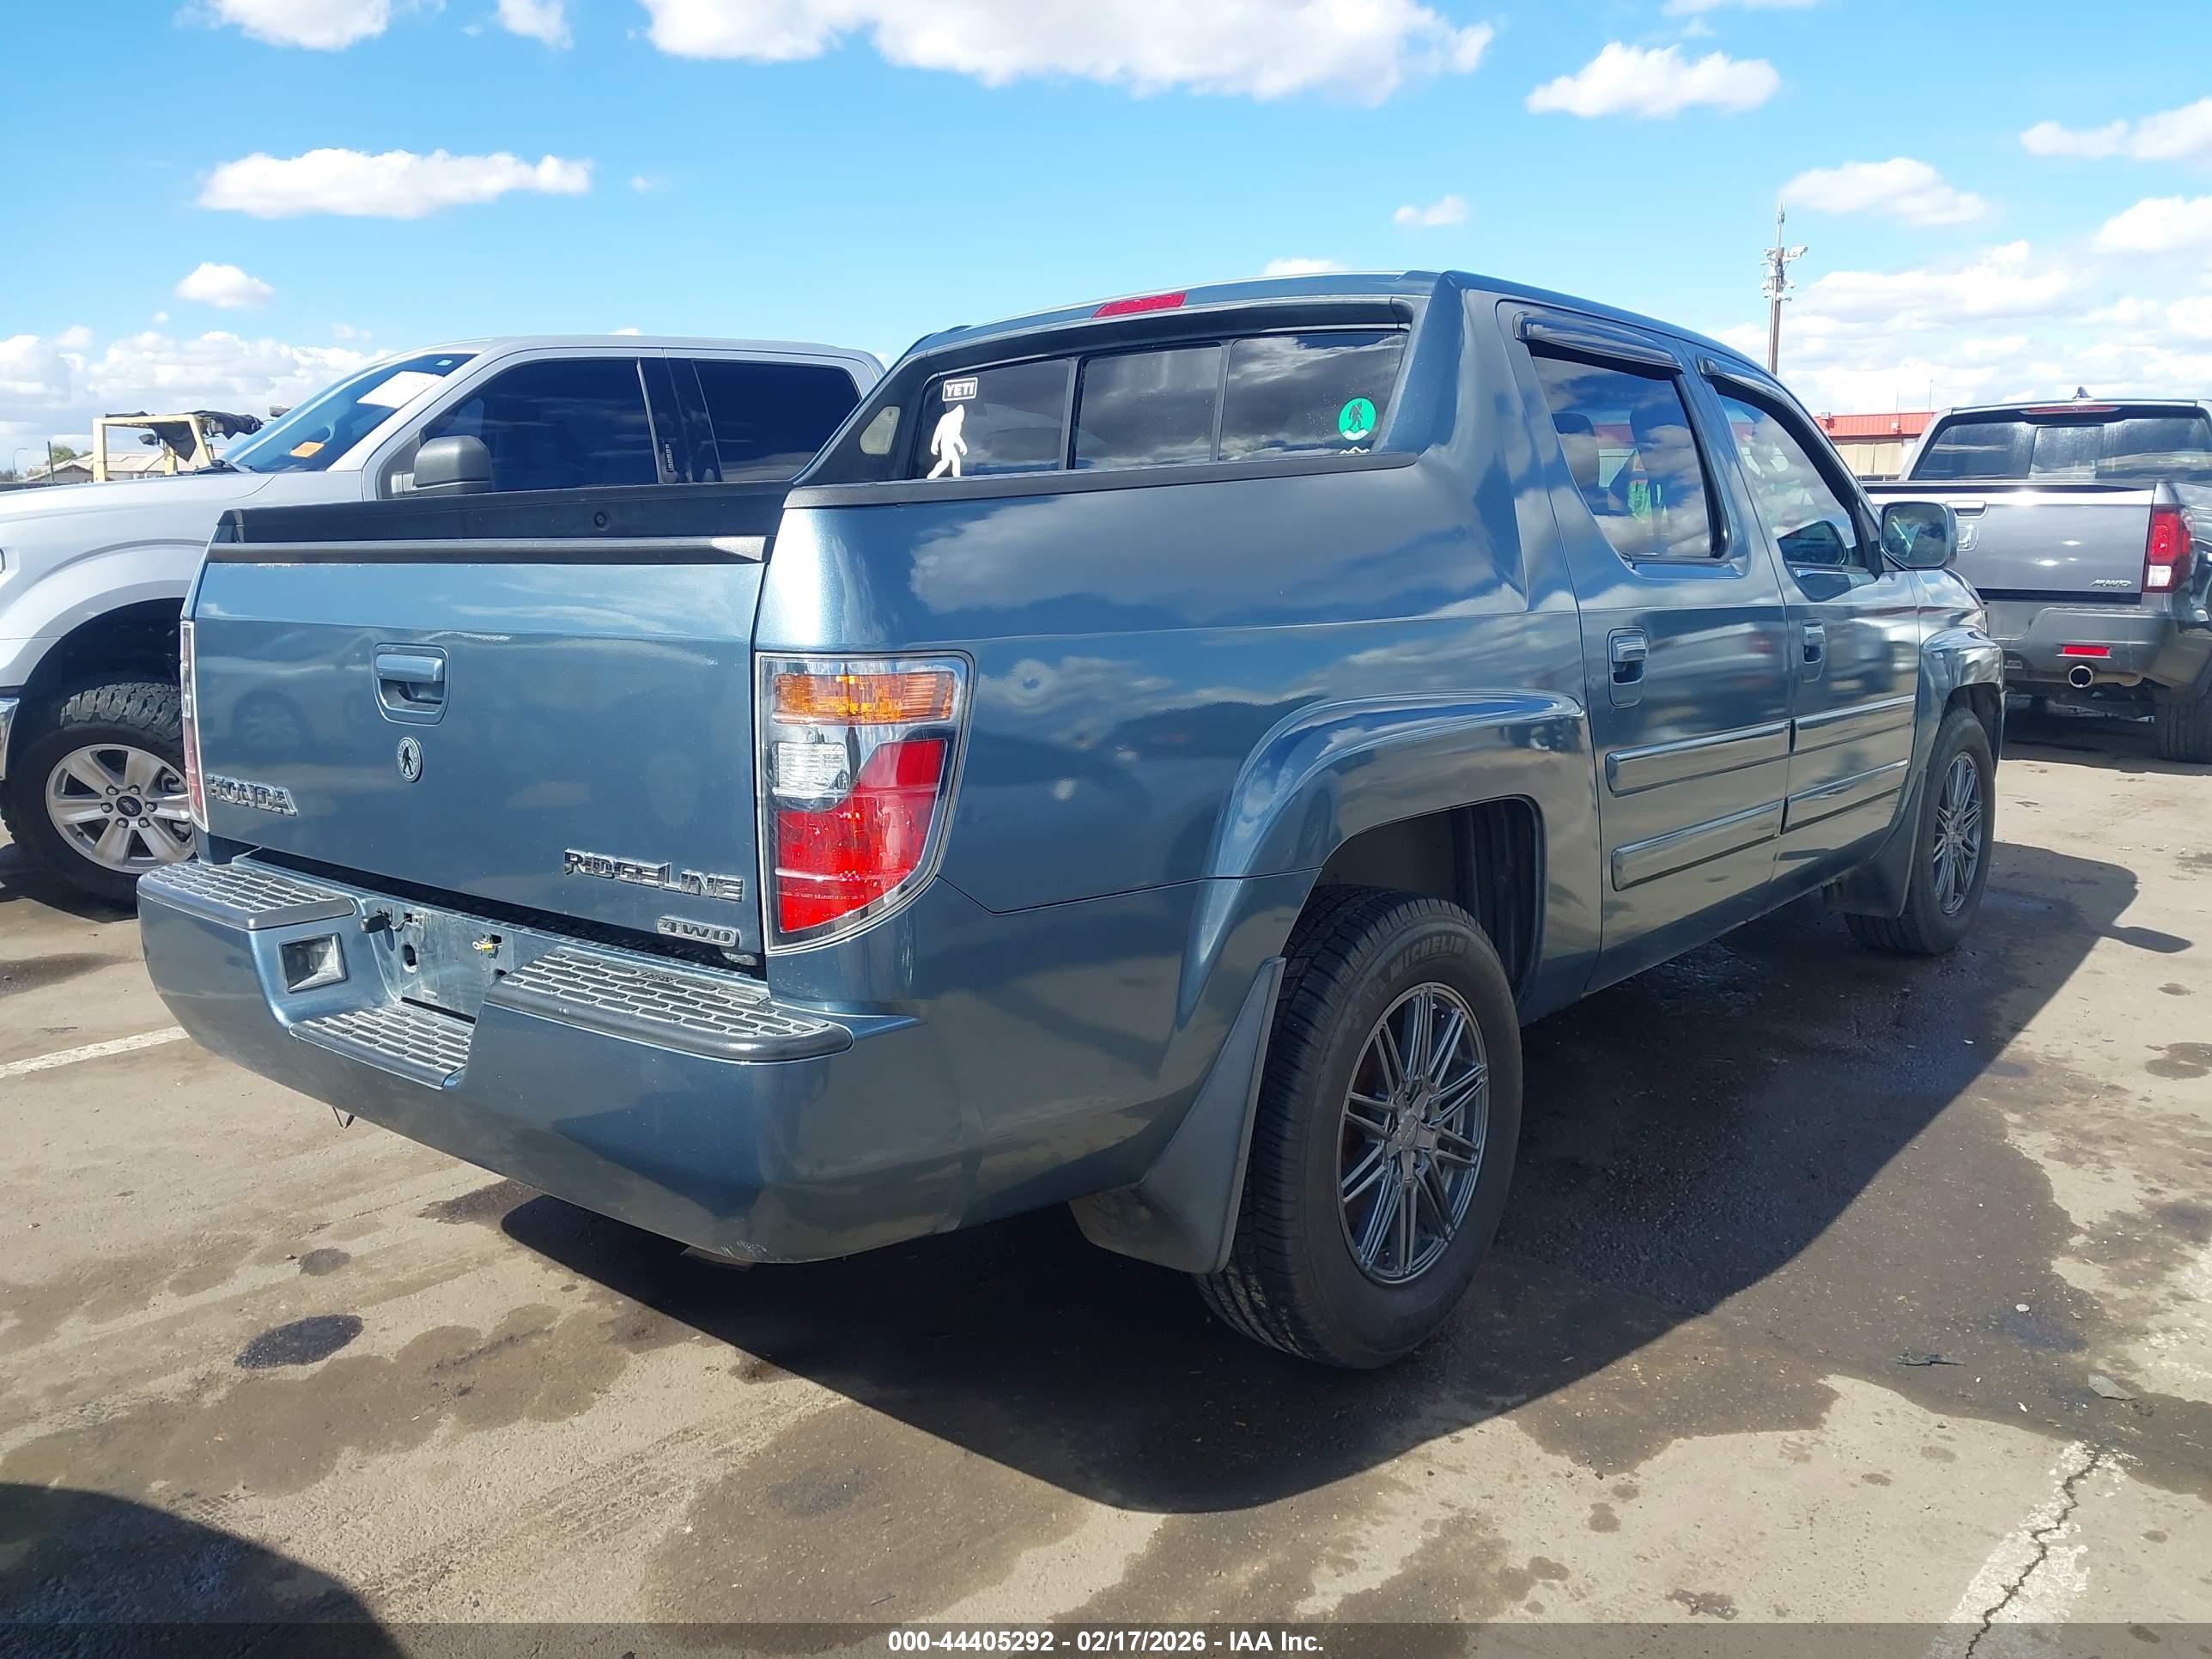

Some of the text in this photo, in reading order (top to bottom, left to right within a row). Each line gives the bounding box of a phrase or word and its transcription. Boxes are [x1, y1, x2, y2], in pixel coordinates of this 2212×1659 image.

[945, 381, 975, 397] YETI
[2090, 579, 2132, 587] AWD
[205, 773, 298, 817] HONDA
[563, 848, 744, 902] RIDGELINE
[658, 917, 736, 944] 4WD
[1389, 934, 1468, 981] MICHELIN
